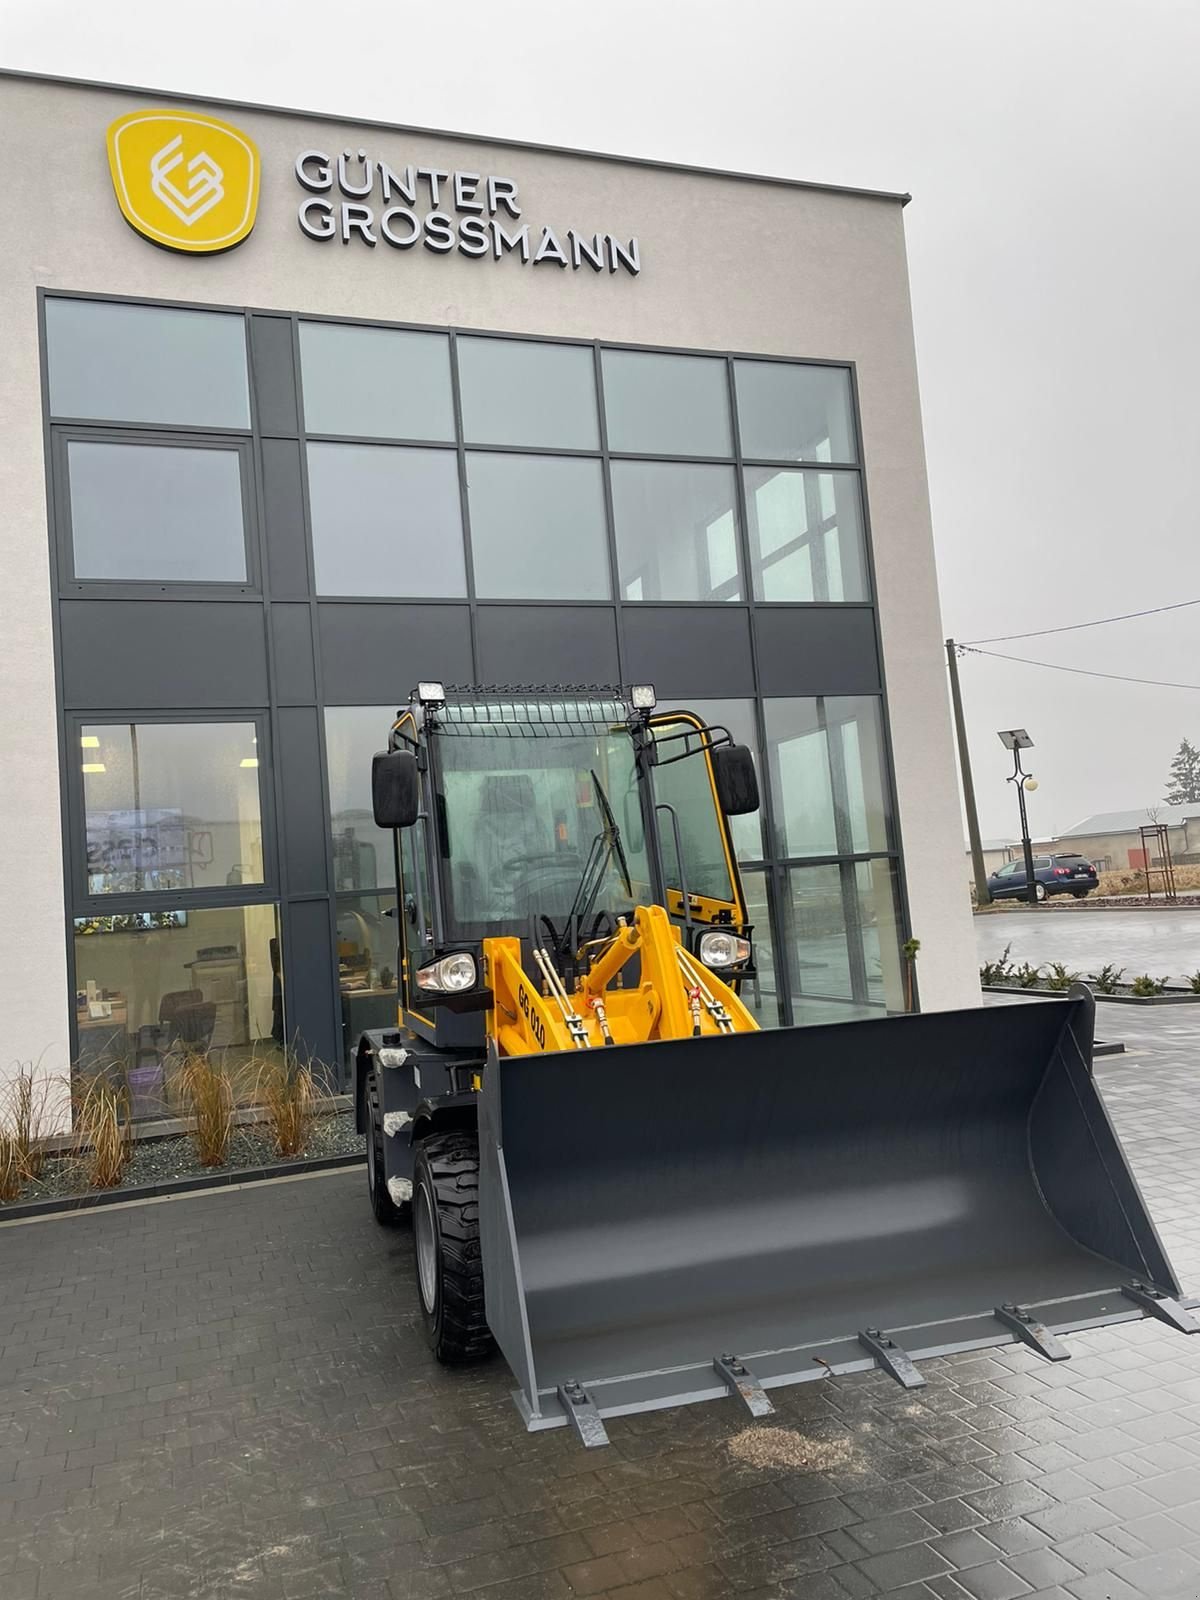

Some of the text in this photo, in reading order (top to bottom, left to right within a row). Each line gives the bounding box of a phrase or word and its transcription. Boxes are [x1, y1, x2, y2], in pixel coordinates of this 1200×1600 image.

[295, 148, 521, 219] GÜNTER
[298, 197, 641, 276] GROSSMANN
[519, 984, 529, 1018] GG
